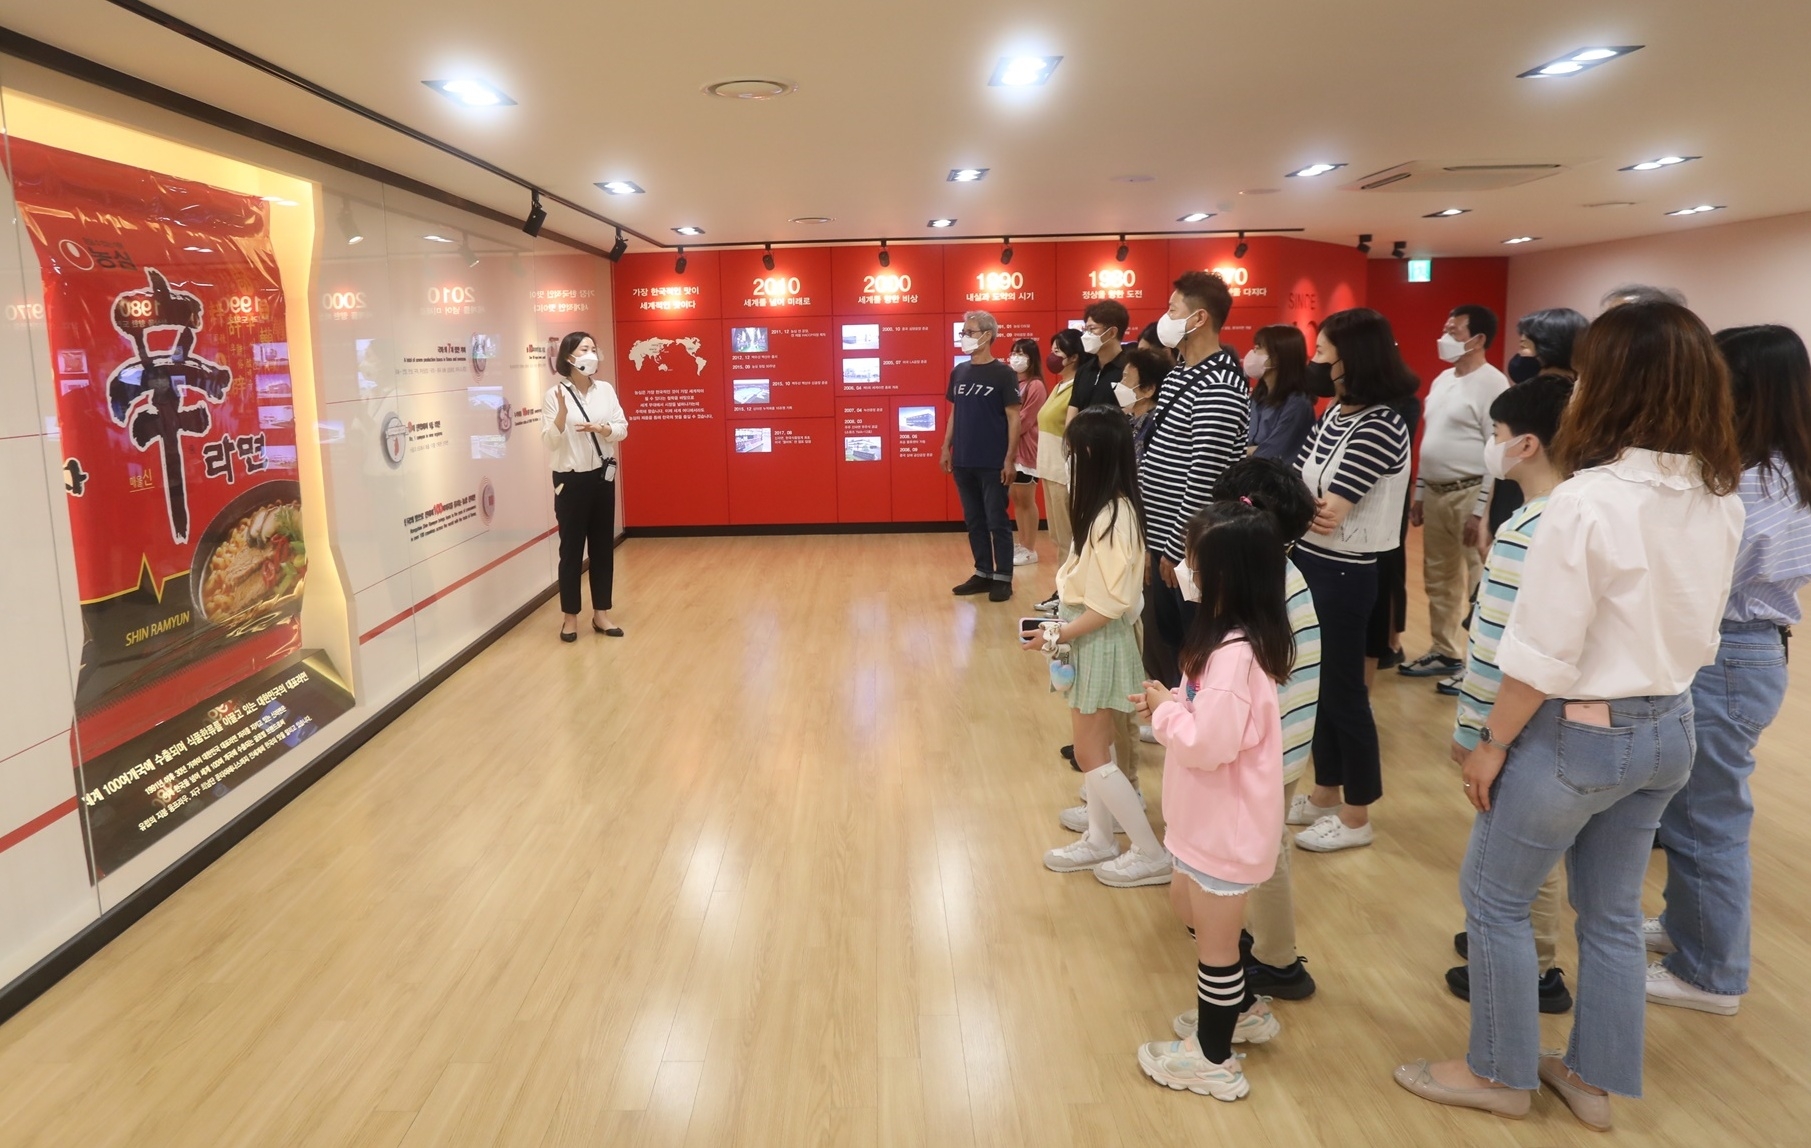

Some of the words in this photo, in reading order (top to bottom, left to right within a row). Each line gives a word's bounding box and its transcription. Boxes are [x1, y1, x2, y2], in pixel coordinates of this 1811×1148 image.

[88, 247, 138, 271] 농심
[753, 276, 801, 296] 2010
[864, 274, 912, 293] 2000
[976, 272, 1024, 290] 1990
[1088, 270, 1136, 288] 1980
[633, 288, 648, 297] 가장
[858, 296, 882, 304] 세계를
[902, 294, 919, 304] 비상
[966, 292, 990, 302] 내실과
[992, 292, 1016, 301] 도약의
[1018, 292, 1034, 301] 시기
[1082, 290, 1106, 300] 정상을
[1126, 290, 1143, 299] 도전
[1243, 288, 1267, 296] 다지다
[744, 298, 767, 307] 세계를
[788, 297, 811, 306] 미래로
[202, 432, 269, 484] 라면
[125, 626, 149, 646] SHIN
[150, 611, 190, 637] RAMYUN
[103, 759, 156, 795] 100여개국에
[155, 740, 188, 766] 수출되며
[186, 720, 224, 746] 식품한류를
[222, 709, 244, 726] 이끌고
[242, 702, 258, 716] 있는
[256, 684, 288, 706] 대한민국의
[285, 671, 309, 690] 대표라면
